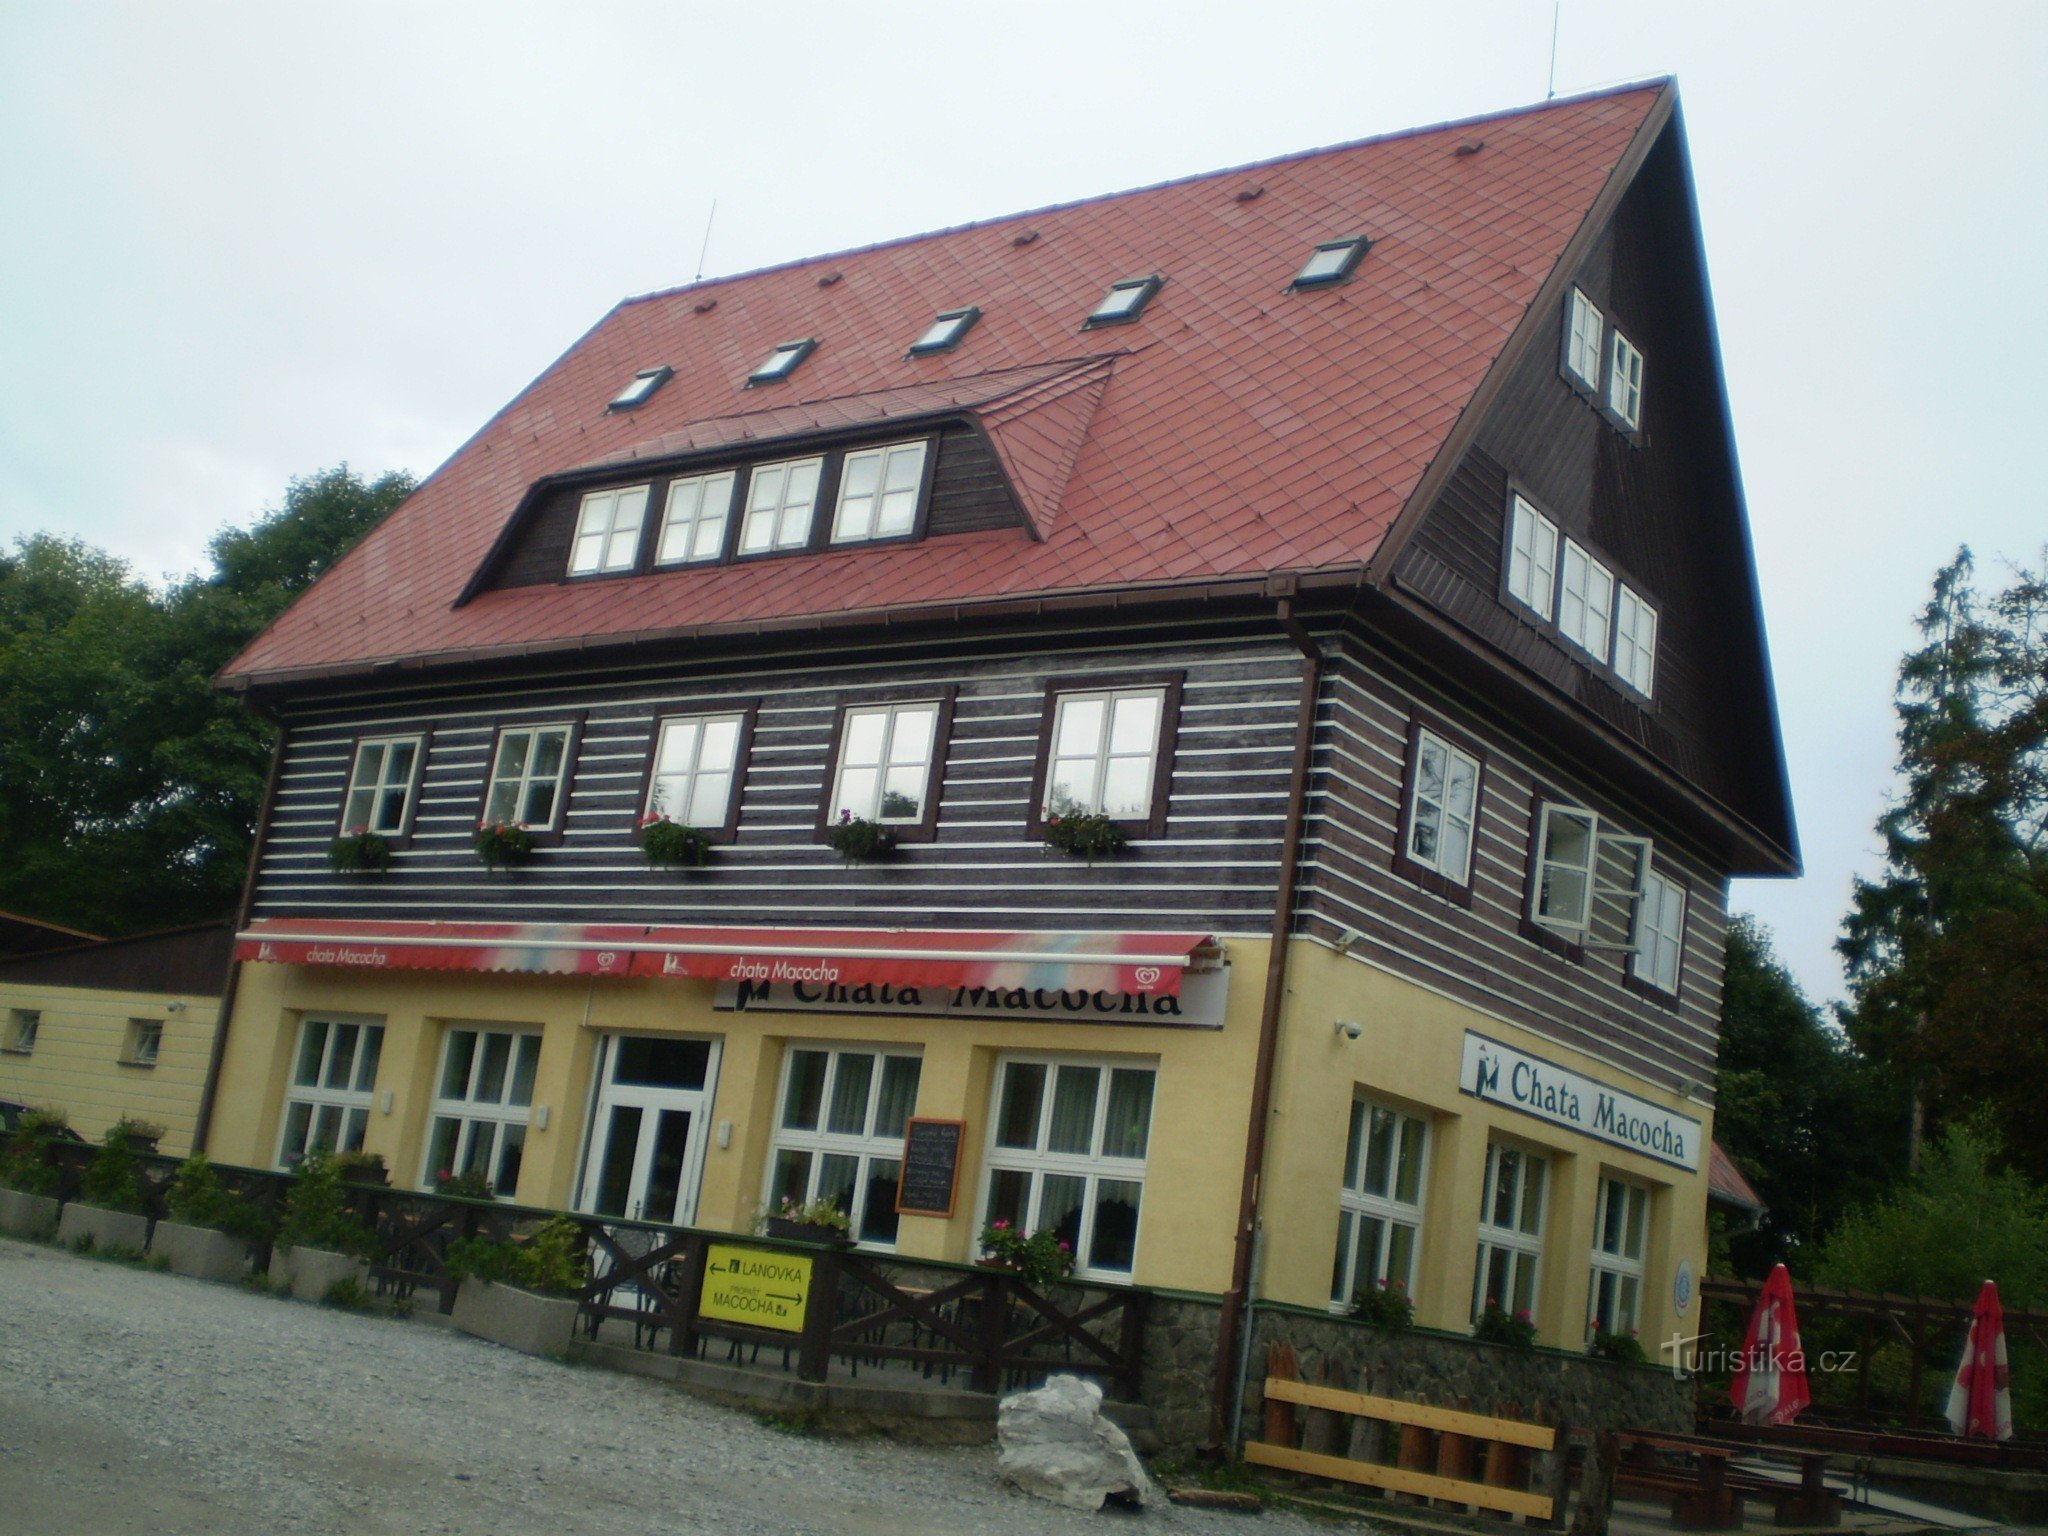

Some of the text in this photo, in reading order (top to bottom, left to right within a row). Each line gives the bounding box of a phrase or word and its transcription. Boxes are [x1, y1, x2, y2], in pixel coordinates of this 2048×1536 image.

[307, 944, 386, 965] chata Macocha
[730, 956, 839, 981] chata Macocha
[1511, 1060, 1685, 1160] Chata Macocha
[742, 1262, 802, 1283] LANOVKA
[713, 1292, 774, 1315] MACOCHA
